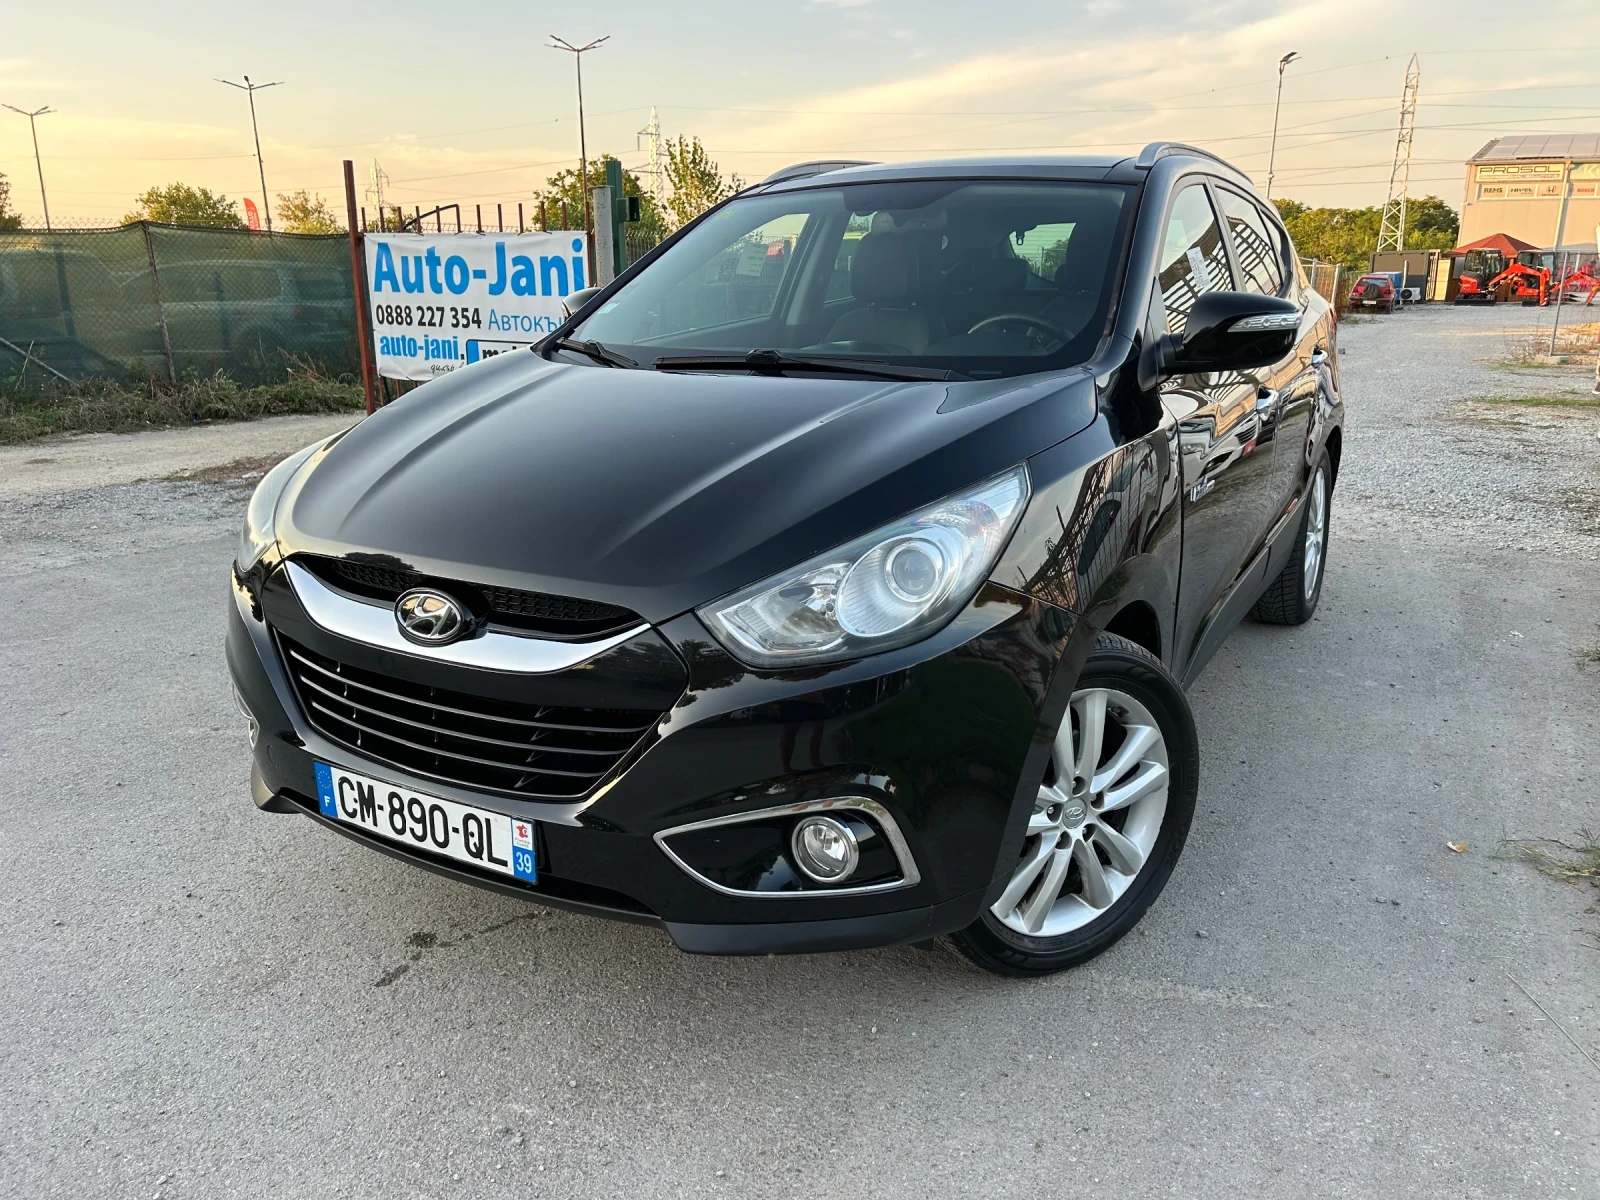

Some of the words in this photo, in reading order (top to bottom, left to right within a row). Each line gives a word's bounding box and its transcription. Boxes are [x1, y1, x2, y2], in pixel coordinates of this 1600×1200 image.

[1479, 166, 1561, 174] PROSOL
[374, 238, 585, 297] Auto-Jani
[376, 304, 413, 326] 0888
[417, 306, 445, 328] 227
[451, 307, 482, 329] 354
[324, 795, 331, 806] F
[338, 776, 508, 868] CM-890-QL
[515, 851, 532, 874] 39
